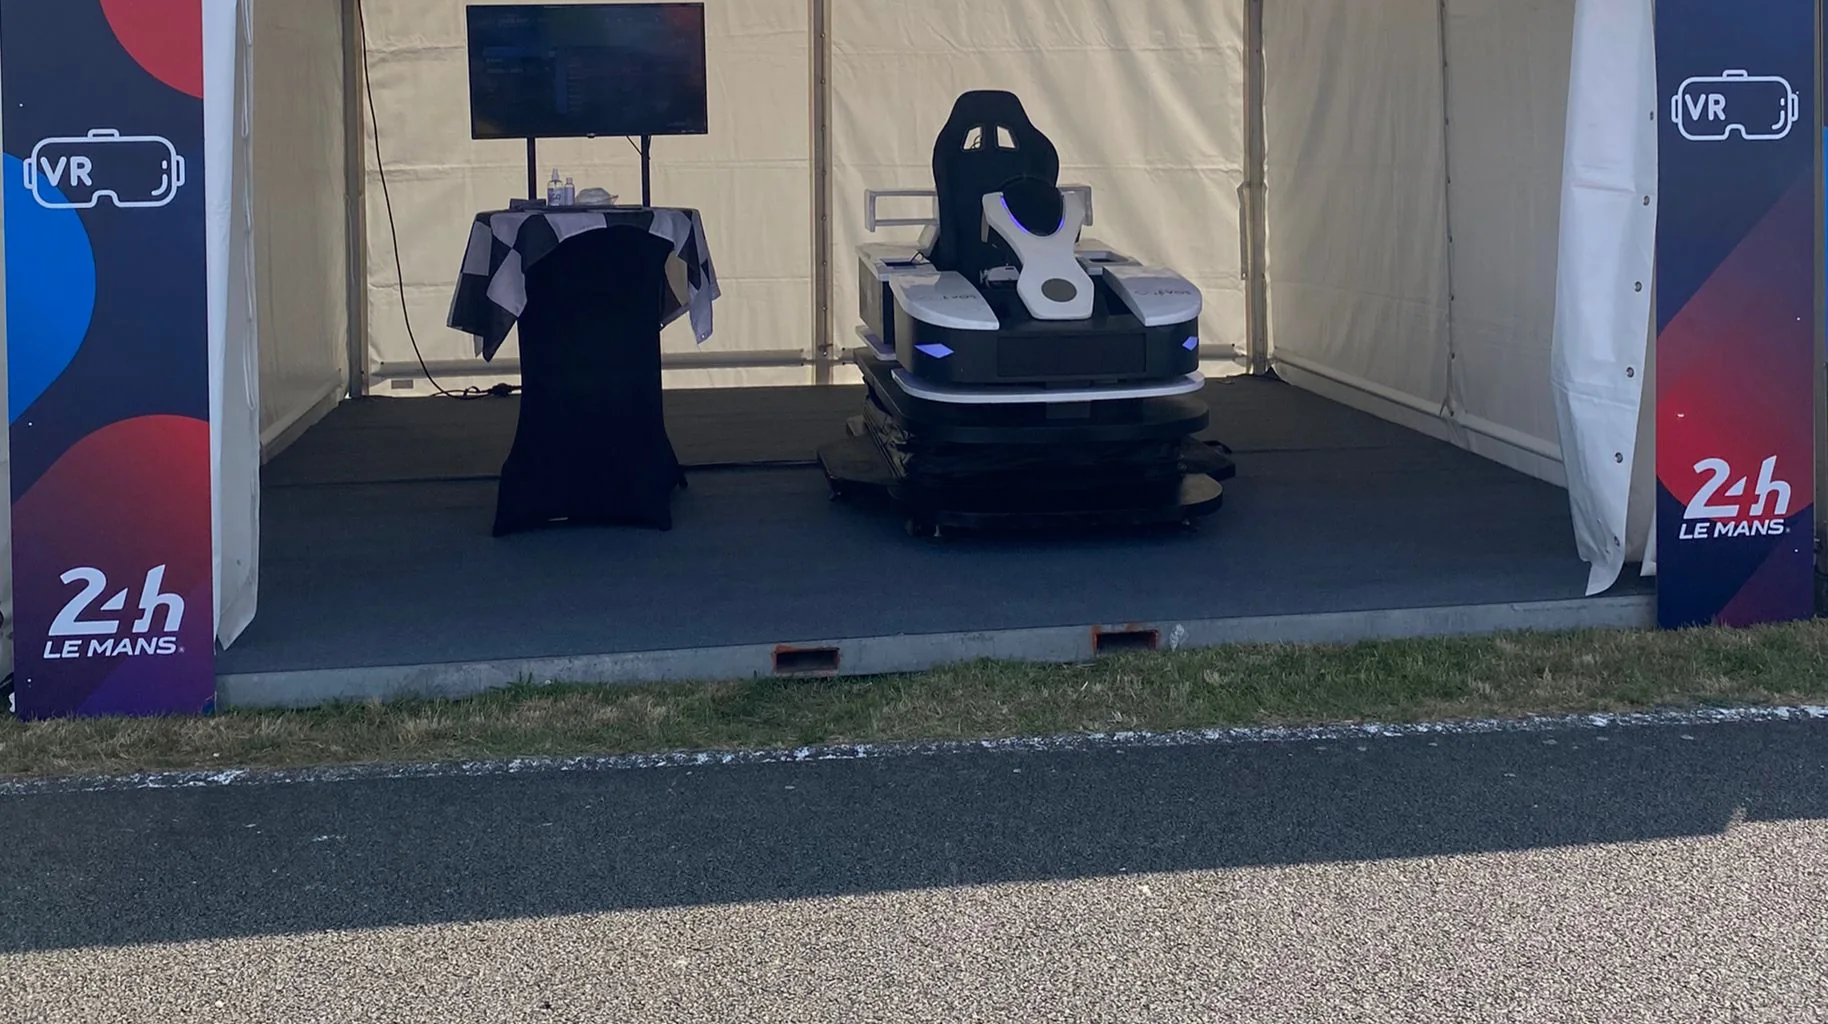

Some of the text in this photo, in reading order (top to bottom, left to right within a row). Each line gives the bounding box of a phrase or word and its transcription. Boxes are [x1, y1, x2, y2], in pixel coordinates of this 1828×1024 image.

[1684, 94, 1726, 120] VR
[40, 156, 92, 187] VR
[1683, 455, 1791, 519] 24h
[1679, 519, 1785, 539] LE MANS
[48, 564, 185, 636] 24h
[43, 636, 177, 659] LE MANS
